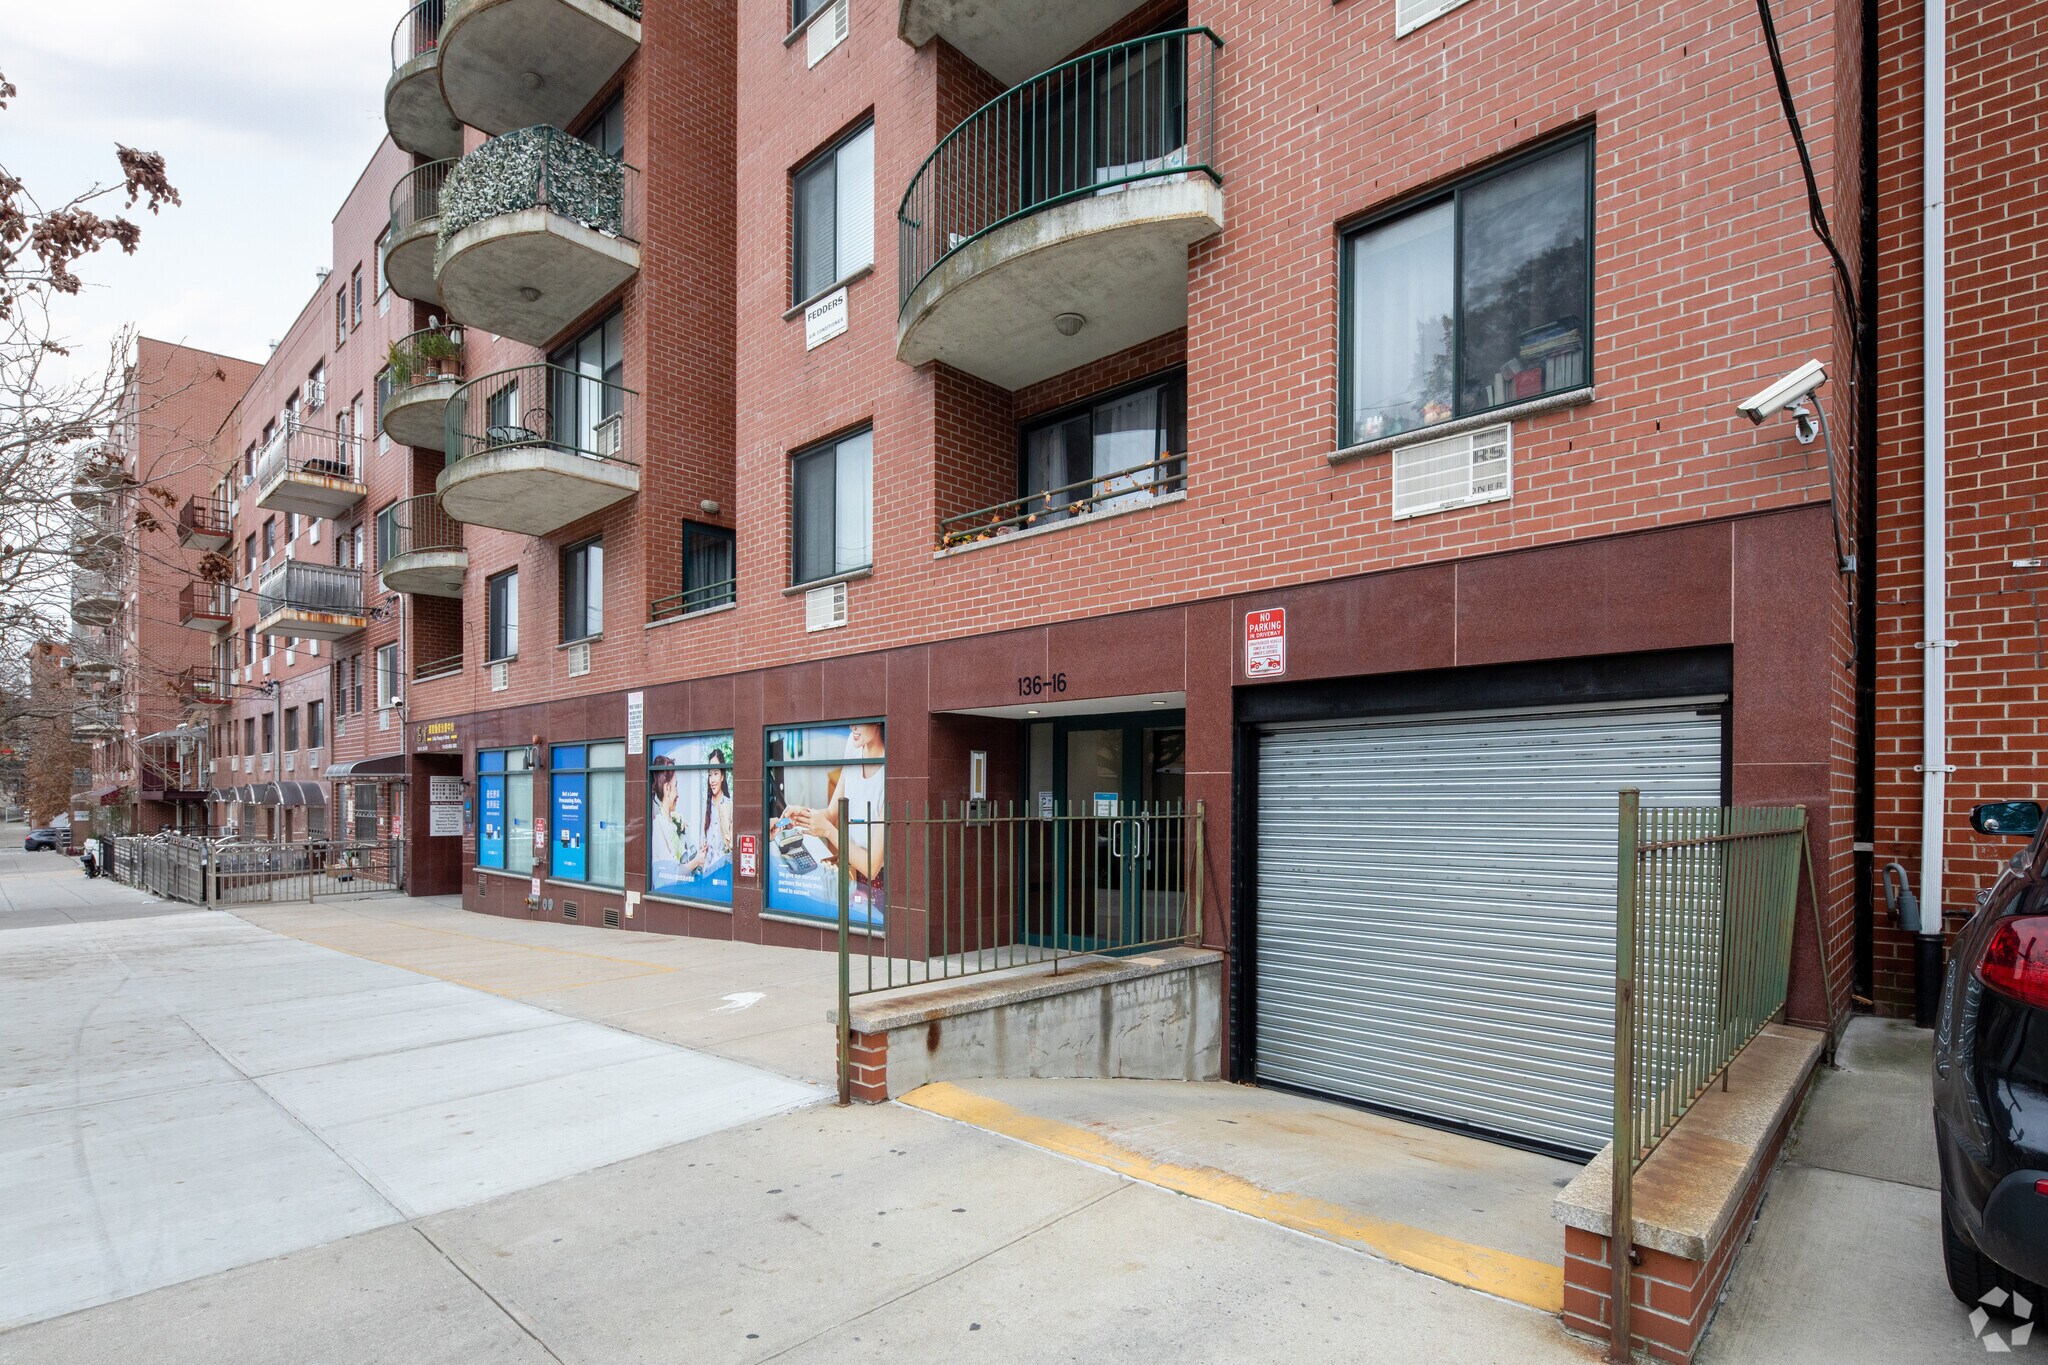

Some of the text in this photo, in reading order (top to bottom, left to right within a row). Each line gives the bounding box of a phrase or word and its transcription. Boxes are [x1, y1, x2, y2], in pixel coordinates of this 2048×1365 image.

[808, 296, 843, 321] FEDDERS
[1260, 612, 1270, 622] NO
[1249, 620, 1282, 633] PARKING
[1256, 630, 1281, 638] DRIVEWAY
[1018, 672, 1067, 696] 136-16
